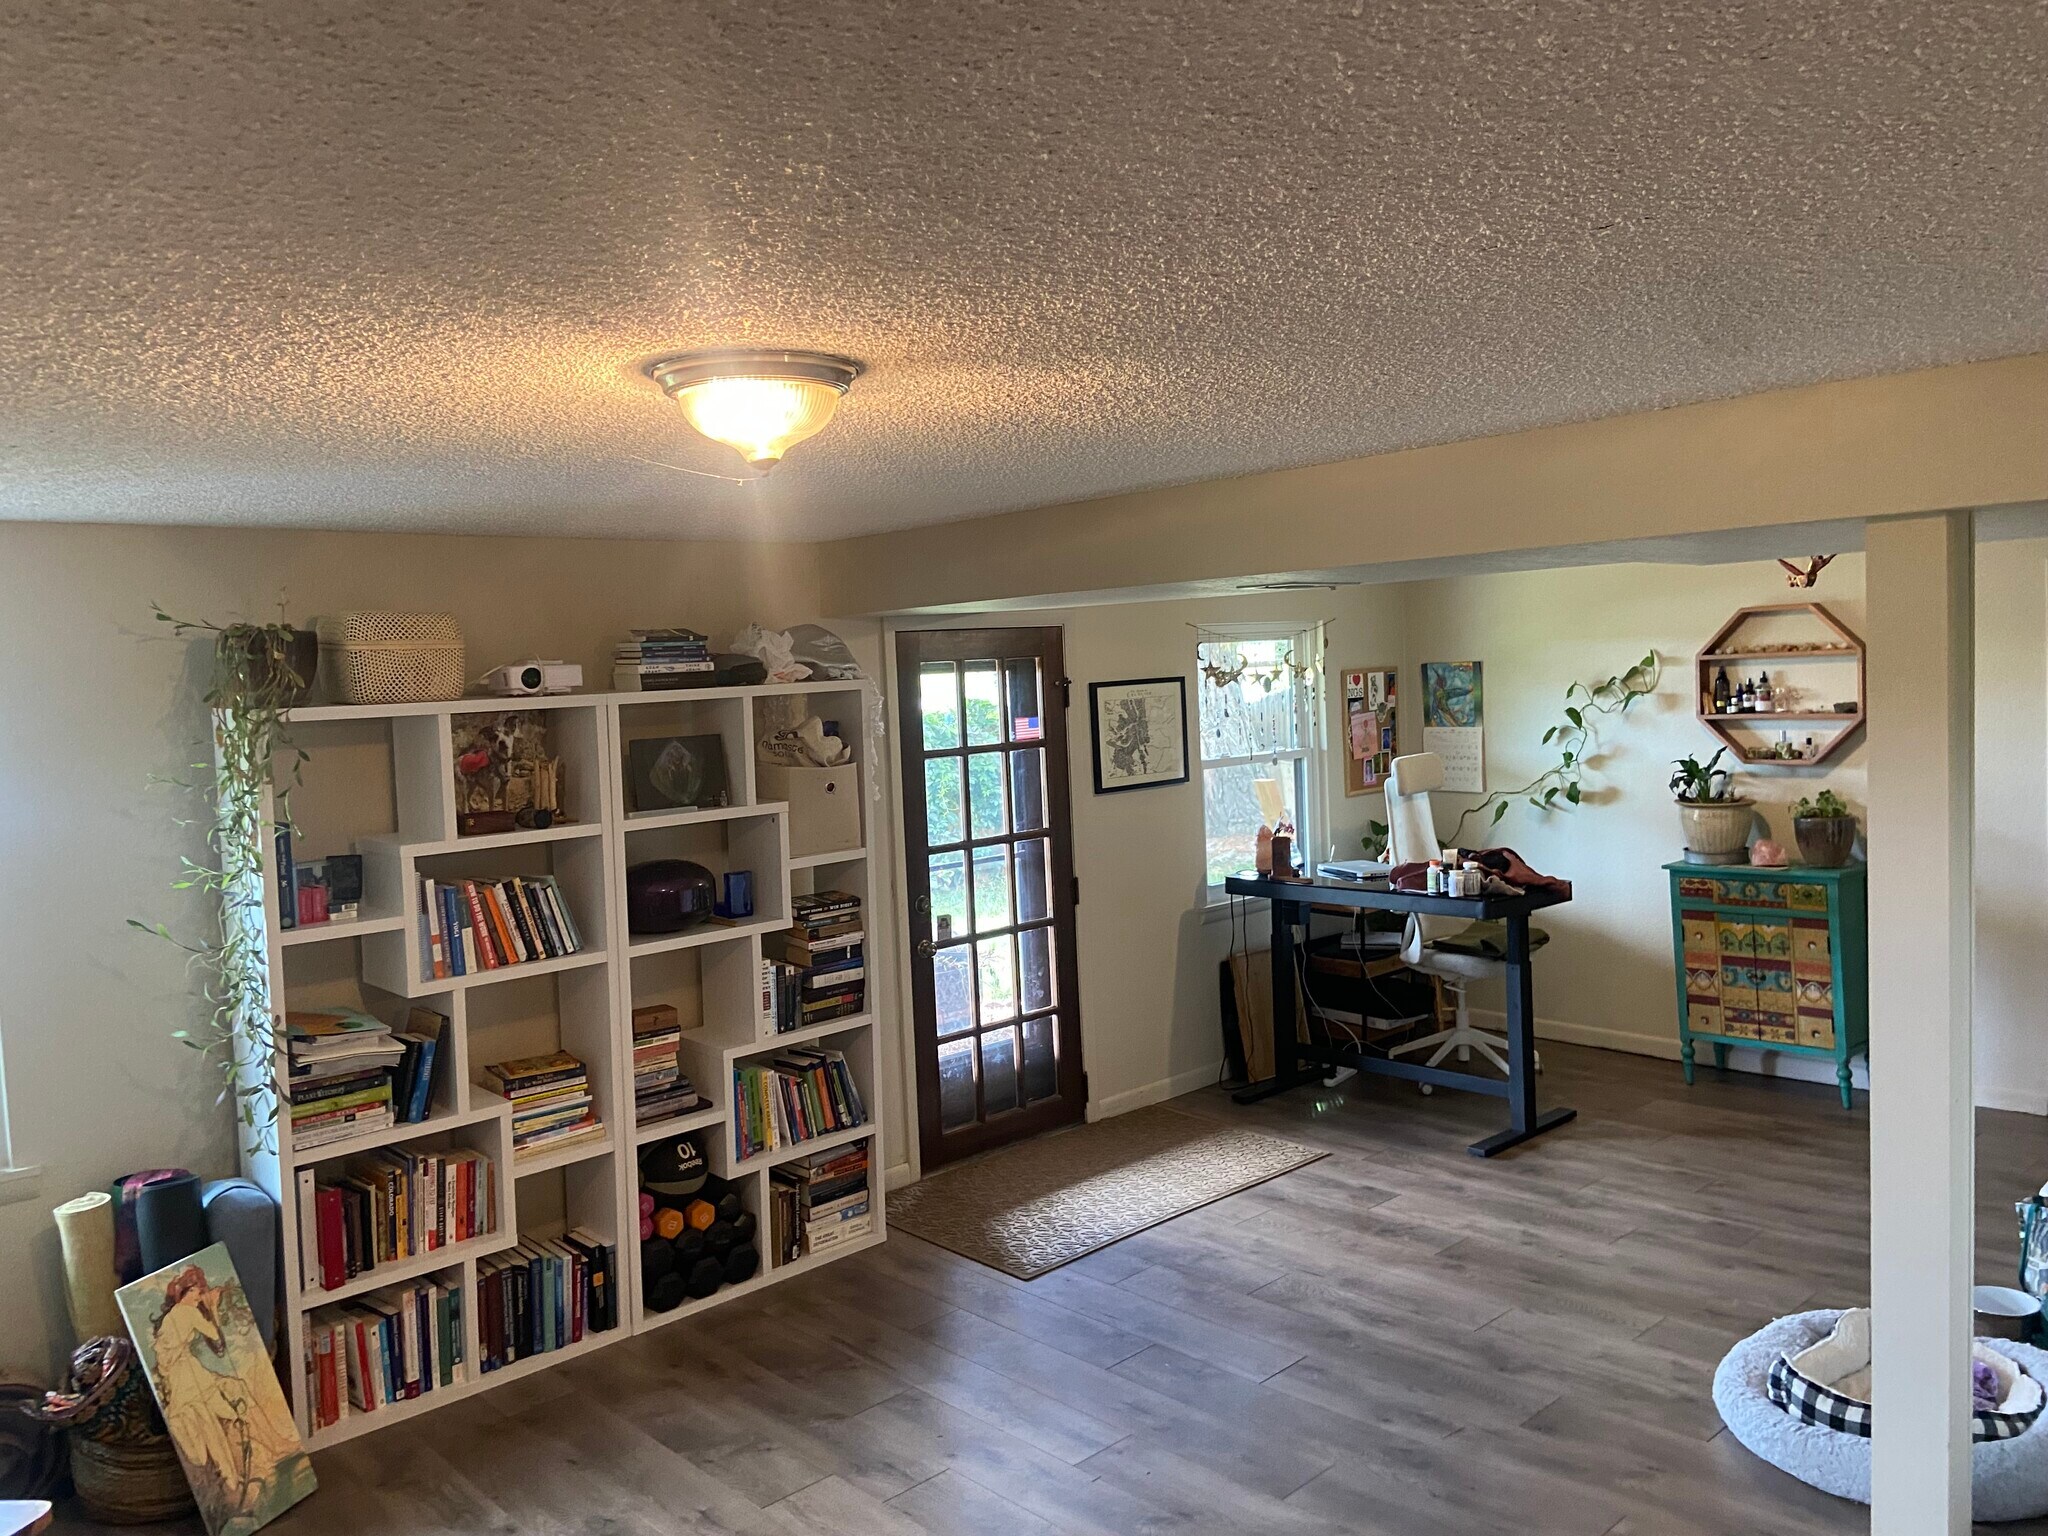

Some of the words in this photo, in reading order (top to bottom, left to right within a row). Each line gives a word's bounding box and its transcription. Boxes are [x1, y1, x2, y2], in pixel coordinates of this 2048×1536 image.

[1348, 687, 1363, 698] NGS
[761, 740, 804, 754] namaste
[452, 920, 460, 938] YOGI
[677, 1141, 697, 1159] 10
[678, 1158, 703, 1171] Reebok
